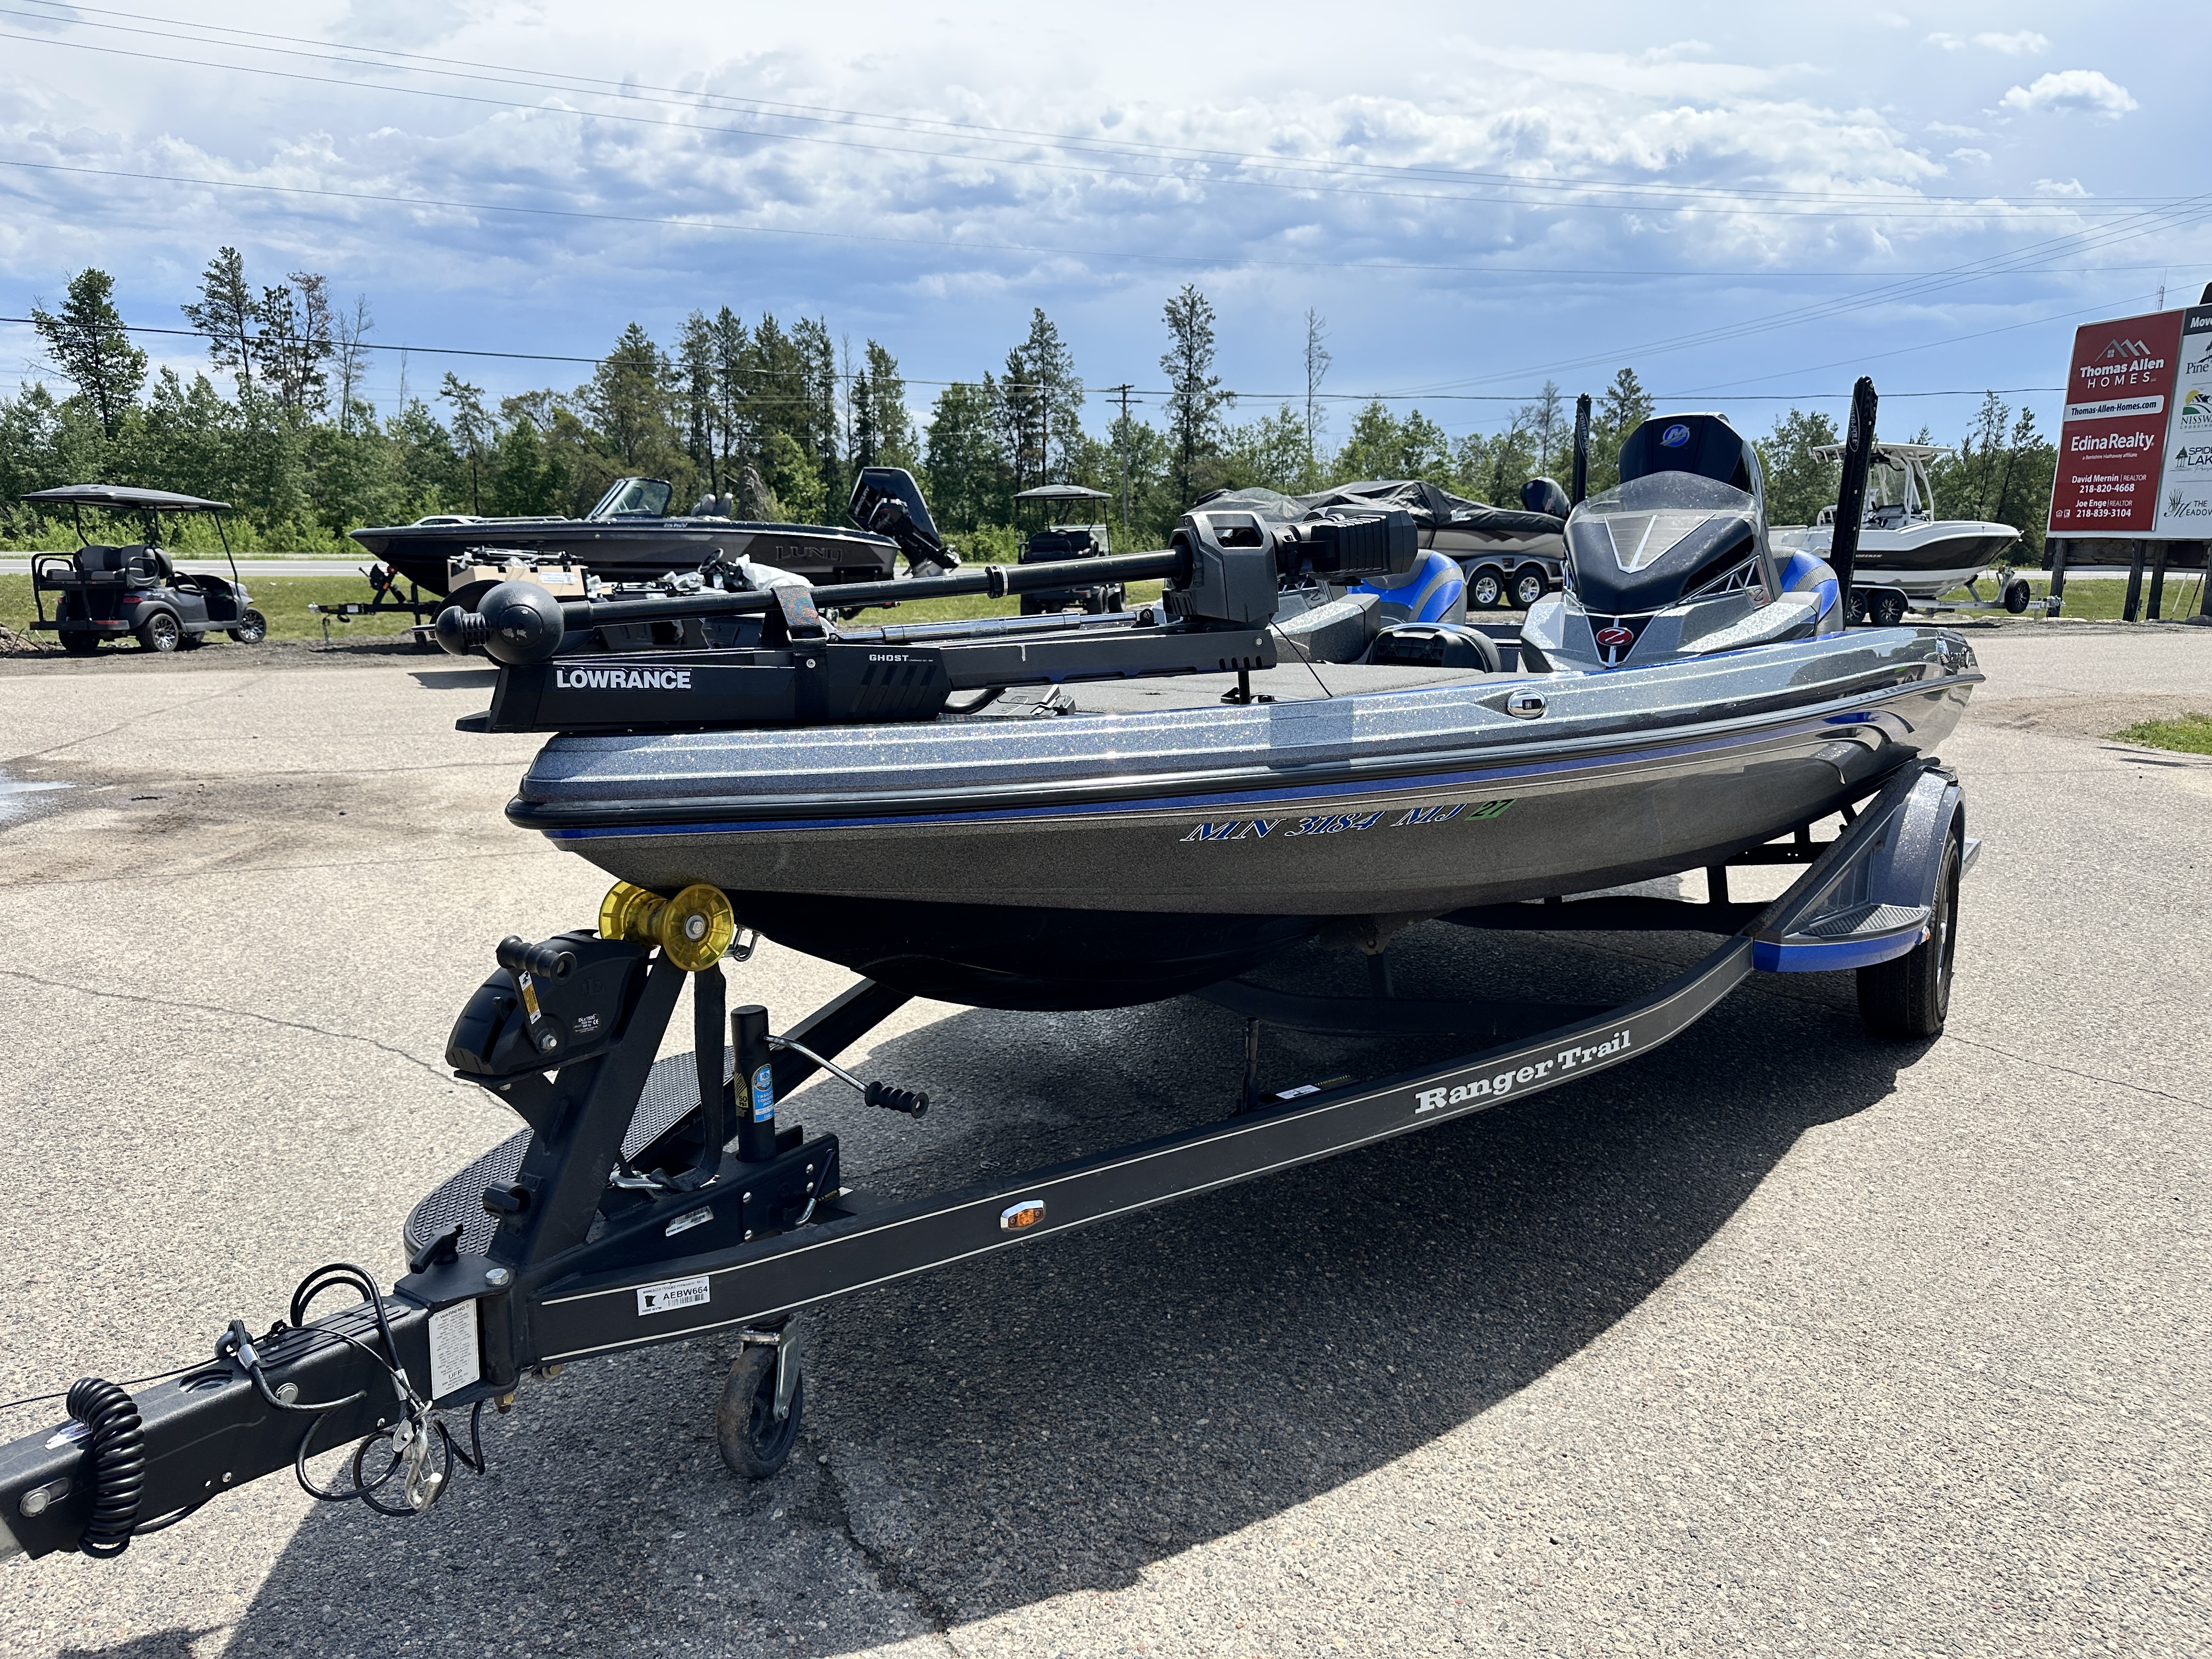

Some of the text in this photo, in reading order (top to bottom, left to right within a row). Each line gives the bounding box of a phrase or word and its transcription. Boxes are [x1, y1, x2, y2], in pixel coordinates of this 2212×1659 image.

[2080, 358, 2164, 378] Thomas Allen
[2186, 362, 2209, 375] Pine
[2087, 372, 2150, 389] HOMES
[2072, 401, 2157, 416] Thomas-Allen-Homes.com
[2071, 432, 2154, 452] Edina Realty
[2072, 475, 2092, 483] David
[2093, 473, 2119, 483] Mernin
[2079, 483, 2135, 493] 218-820-4668
[2075, 499, 2087, 507] Joe
[2089, 499, 2107, 508] Enge
[2076, 509, 2131, 518] 218-839-3104
[775, 546, 843, 562] LUND
[556, 670, 691, 689] LOWRANCE
[1470, 799, 1516, 817] 27
[1180, 803, 1468, 842] MN 3184 MJ
[1414, 1030, 1630, 1114] Ranger Trail
[663, 1286, 708, 1301] AEBW664
[440, 1306, 466, 1319] WARNING
[448, 1369, 462, 1379] UFP
